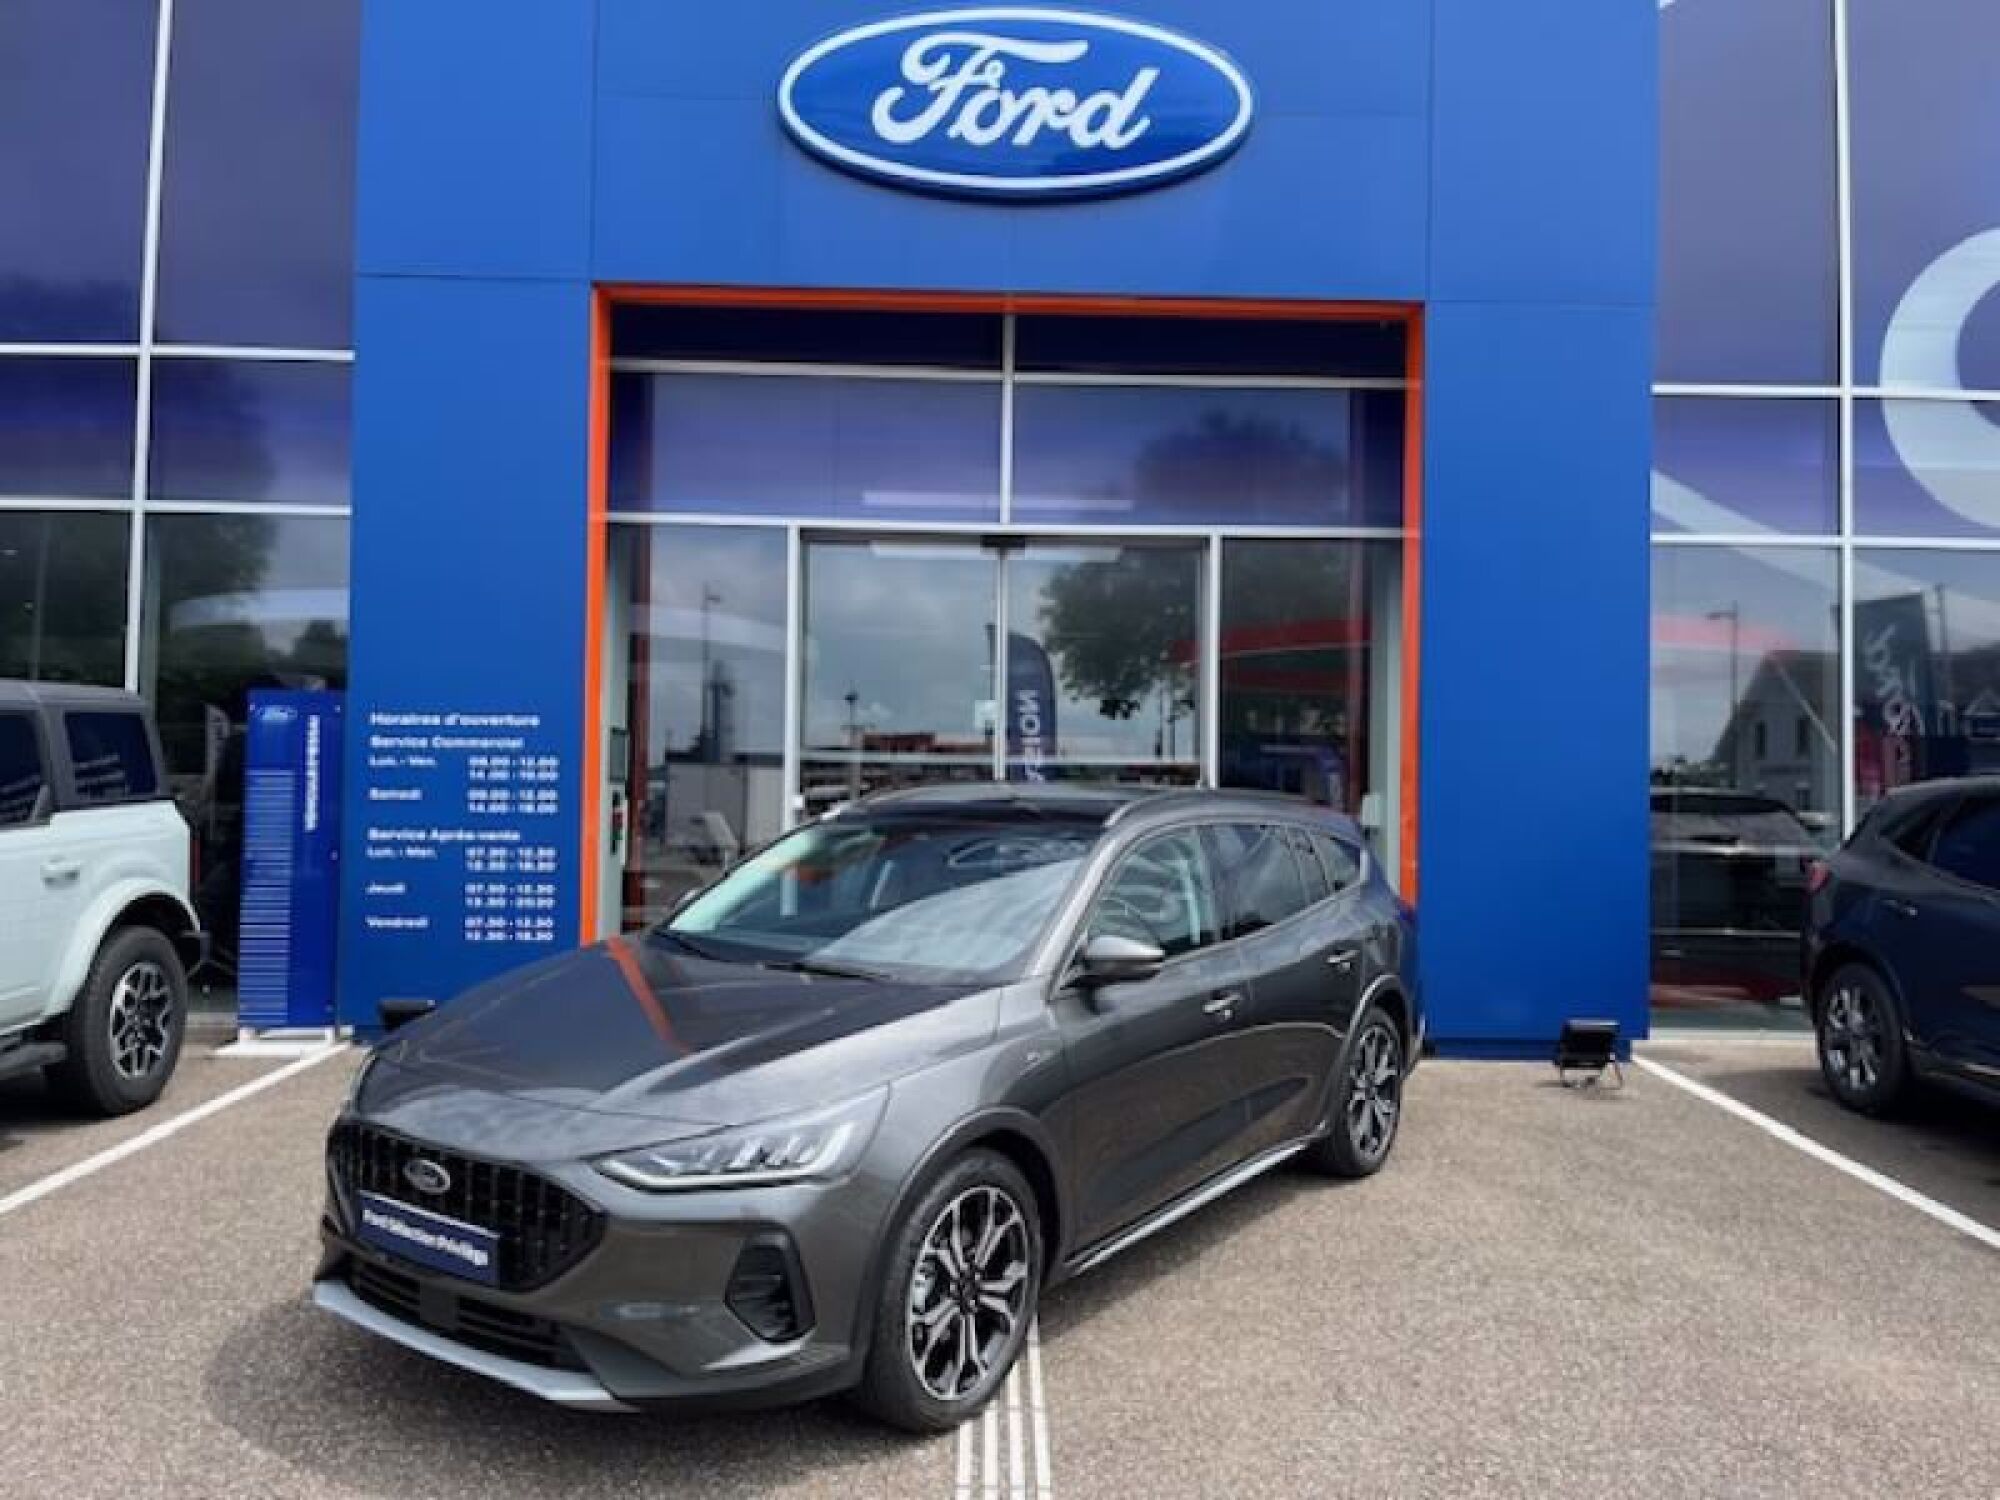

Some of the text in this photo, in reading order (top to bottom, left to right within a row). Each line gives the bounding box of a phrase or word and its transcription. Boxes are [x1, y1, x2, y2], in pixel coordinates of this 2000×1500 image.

[872, 31, 1161, 151] Ford
[370, 712, 541, 727] Horaires d'ouverture
[370, 735, 525, 749] Service Commercial
[369, 788, 423, 801] Samedi
[368, 828, 426, 841] Service
[365, 883, 406, 896] Jeudi
[365, 916, 429, 928] Vendredi
